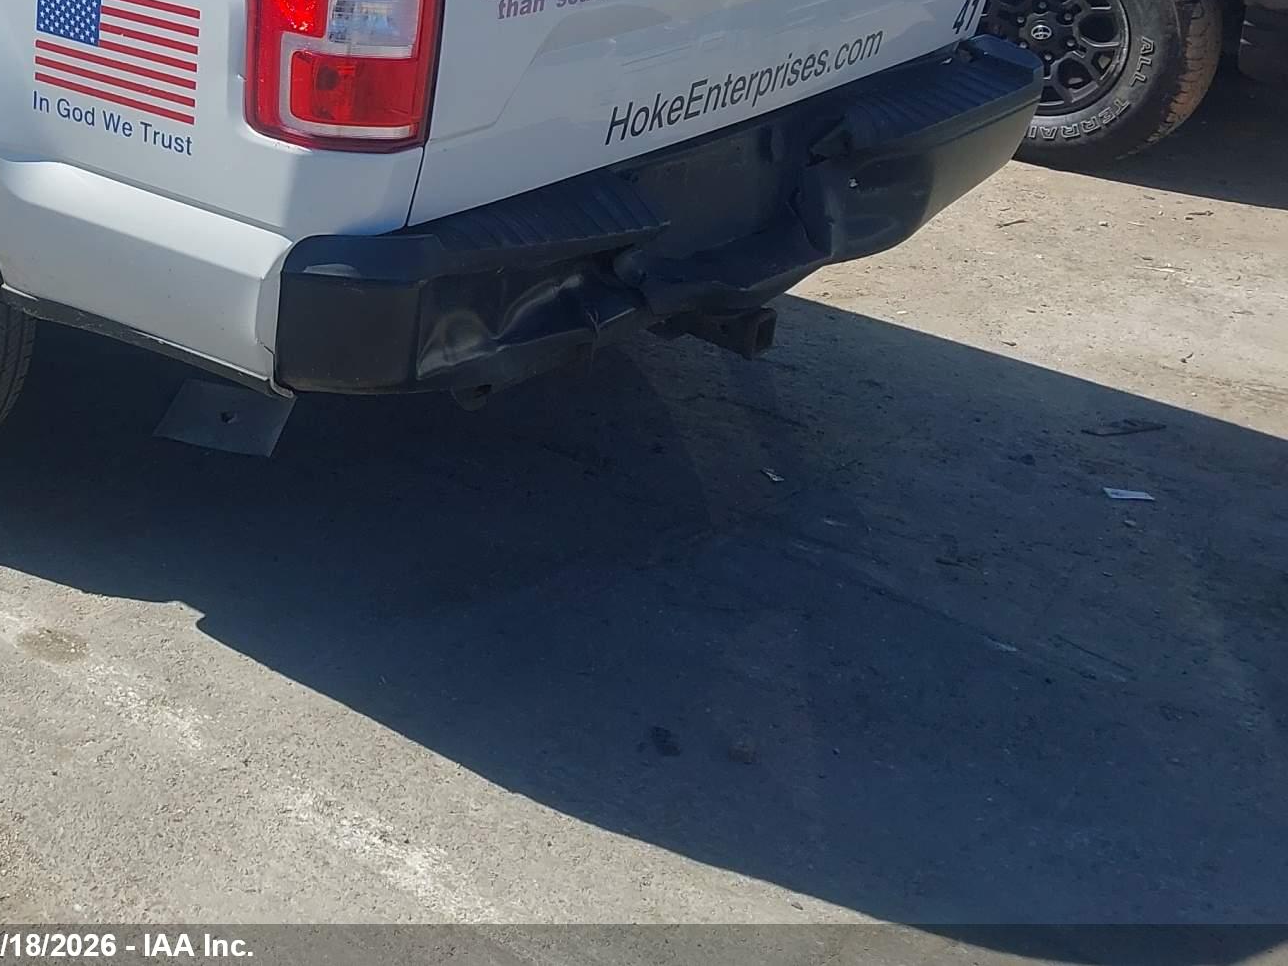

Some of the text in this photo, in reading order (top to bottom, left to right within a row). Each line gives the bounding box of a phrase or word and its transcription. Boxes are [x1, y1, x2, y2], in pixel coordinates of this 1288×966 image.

[604, 29, 883, 146] HokeEnterprises.com
[1130, 36, 1155, 87] ALL
[33, 90, 192, 156] In God We Trust
[1026, 97, 1132, 139] TERRAI
